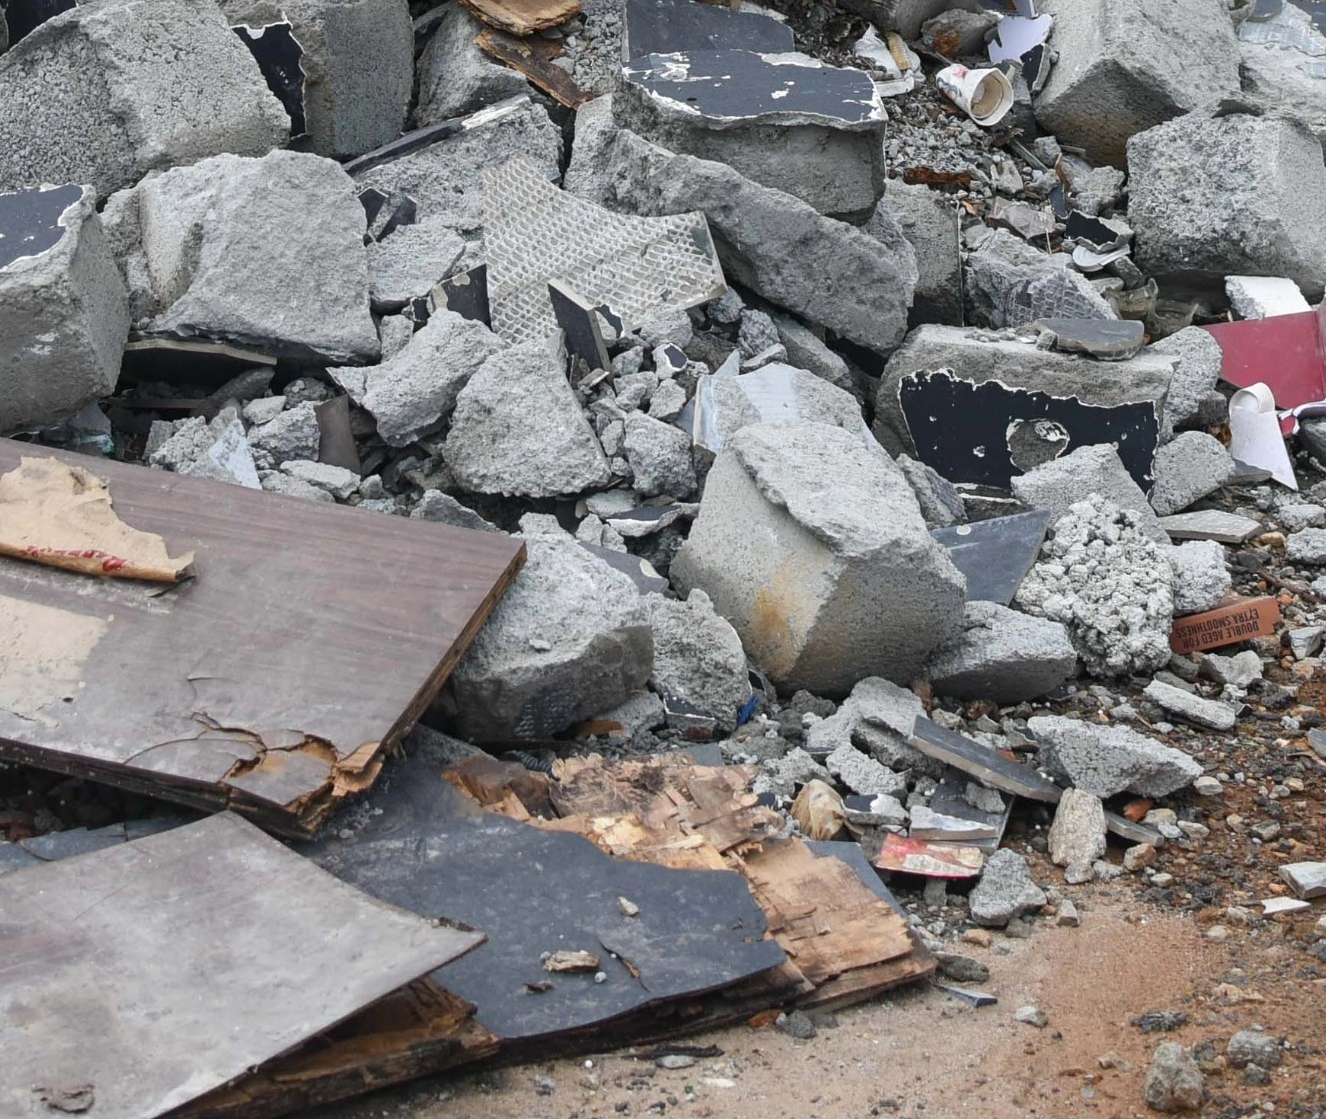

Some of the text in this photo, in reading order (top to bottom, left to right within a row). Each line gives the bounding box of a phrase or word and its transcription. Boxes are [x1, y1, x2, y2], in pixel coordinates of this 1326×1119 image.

[1176, 615, 1231, 638] SMOOTHNESS
[1183, 621, 1259, 648] DOUBLE AGED FOR
